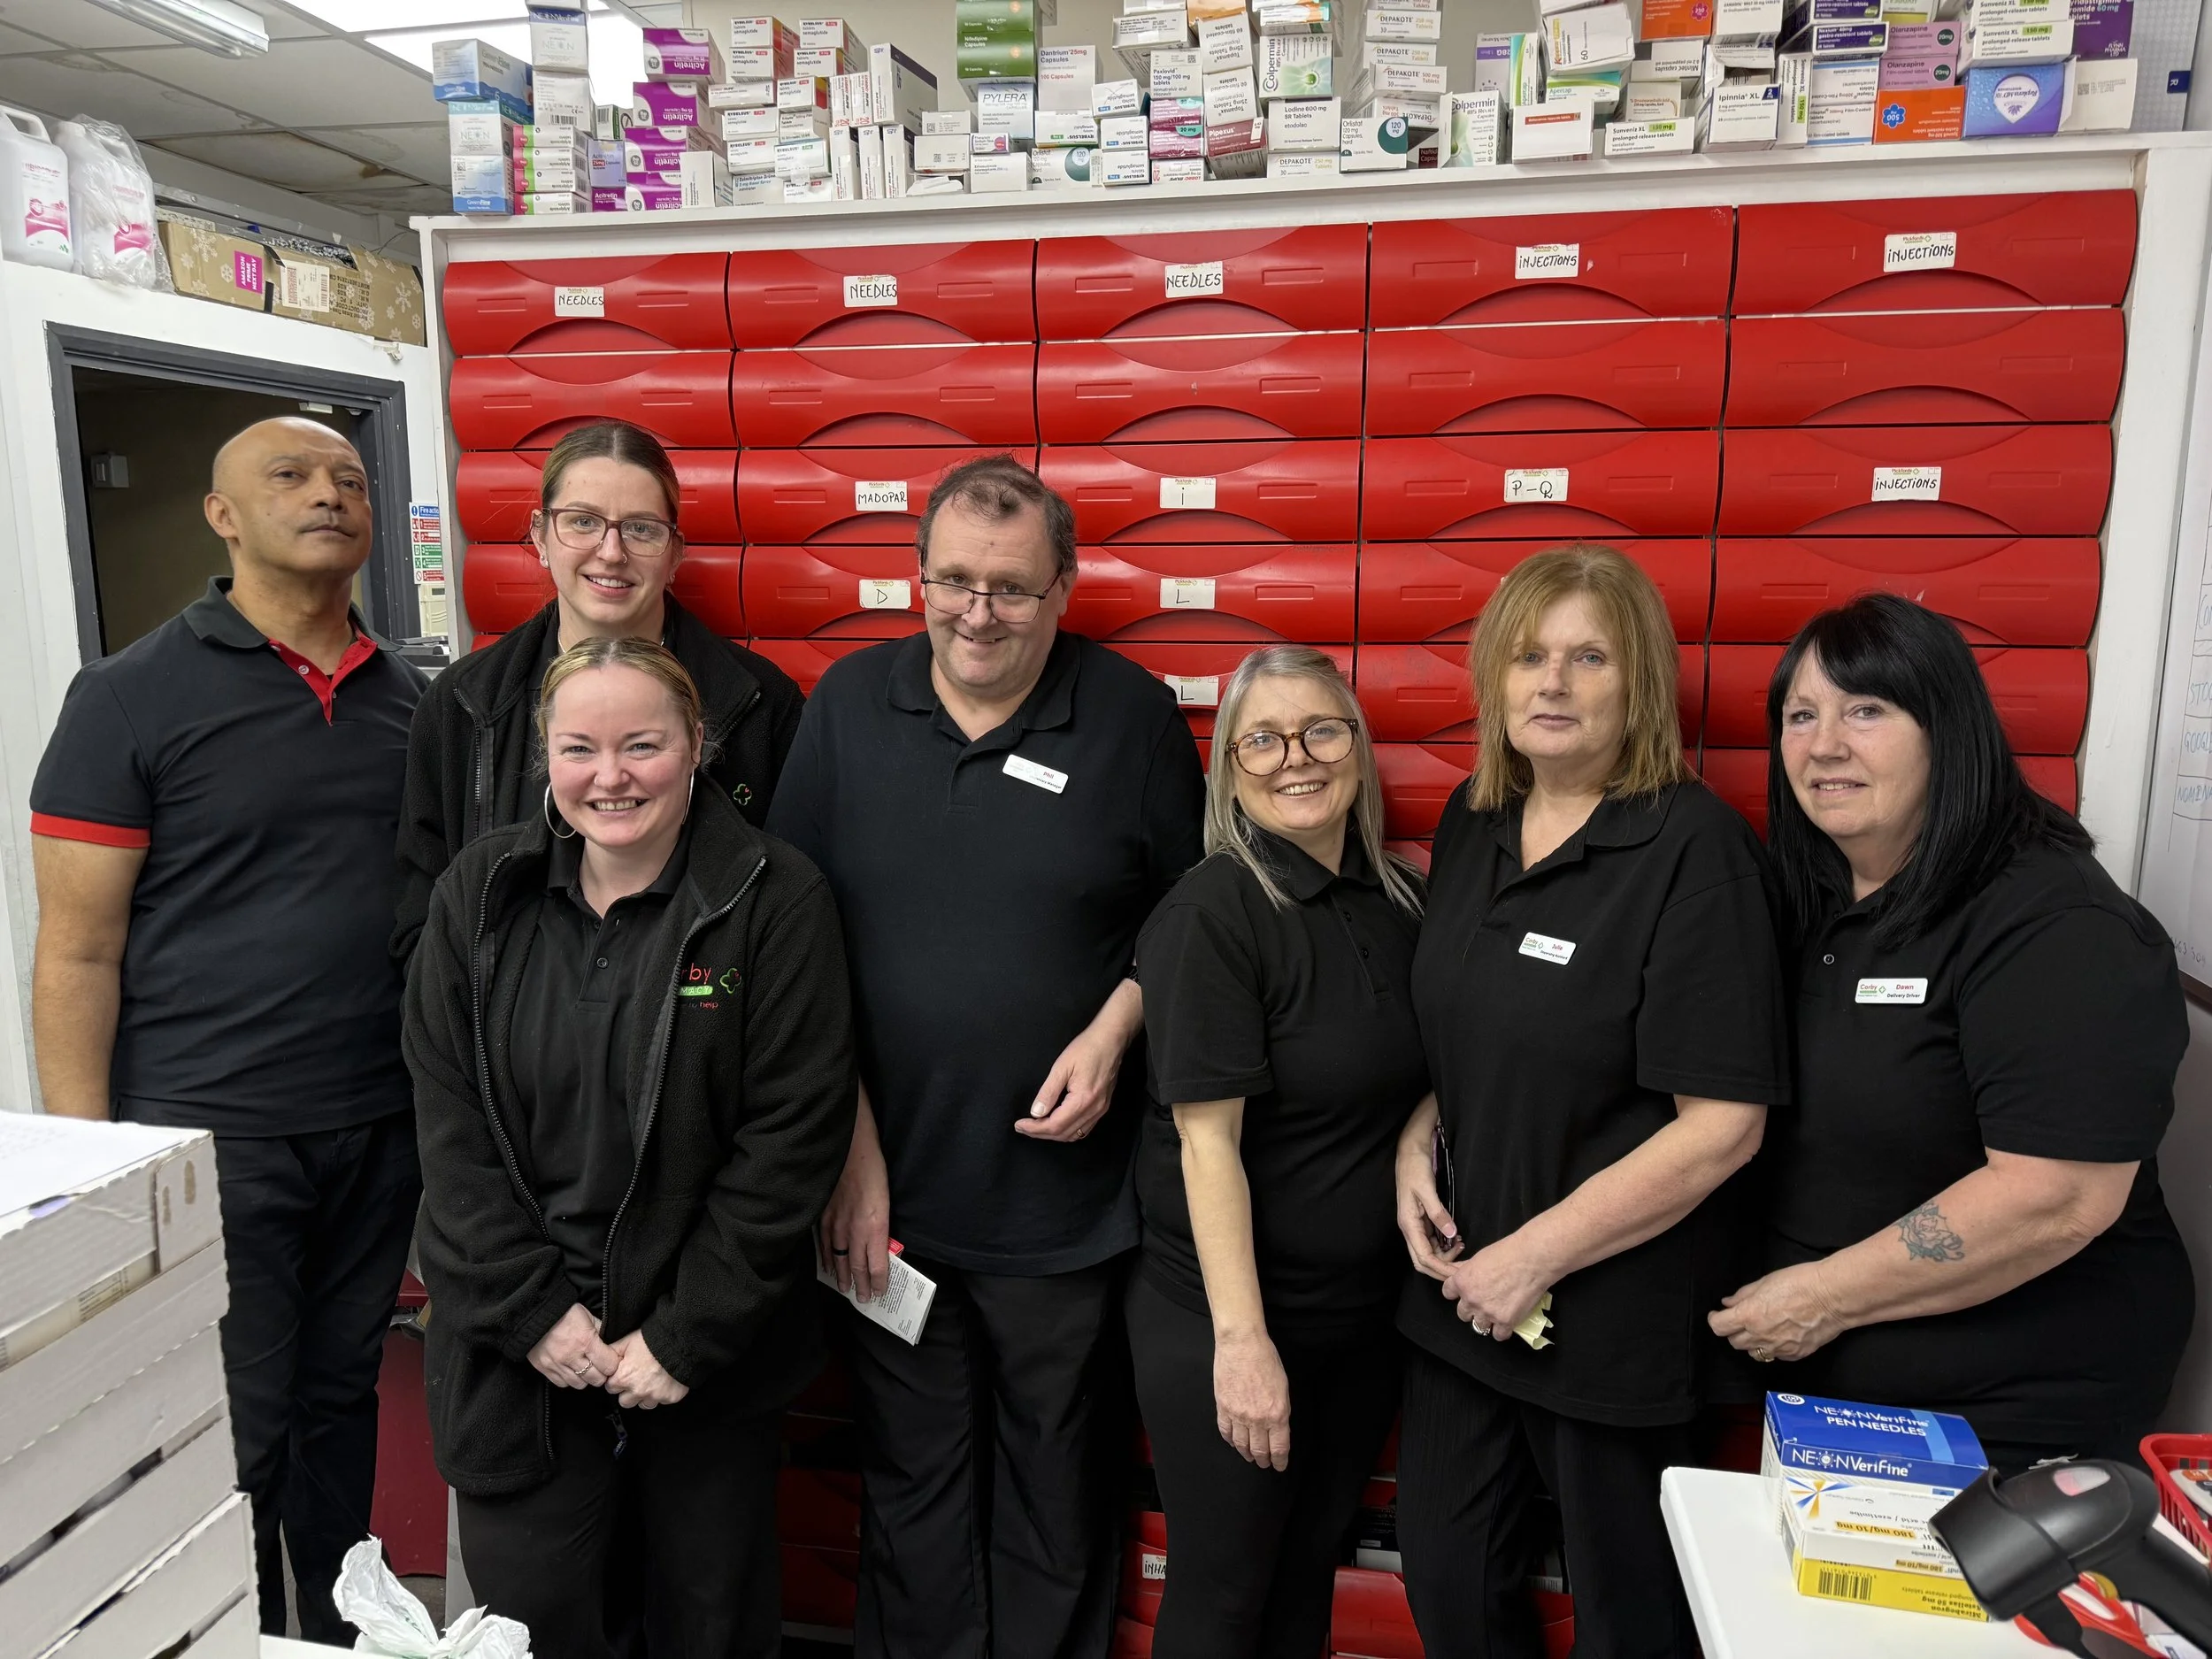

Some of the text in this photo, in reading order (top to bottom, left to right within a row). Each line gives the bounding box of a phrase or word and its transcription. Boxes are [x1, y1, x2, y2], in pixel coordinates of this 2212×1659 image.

[1580, 50, 1588, 60] 60
[1265, 38, 1278, 89] Colpermin
[983, 93, 1025, 103] PYLERA
[1718, 94, 1745, 103] Ipinnia
[1797, 111, 1803, 120] mg
[1209, 127, 1233, 136] Pipexus
[1166, 273, 1221, 289] NEEDLES
[849, 283, 897, 299] NEEDLES
[558, 295, 604, 306] NEEDLES
[1512, 480, 1553, 498] P Q
[857, 491, 907, 503] MADOPAR
[877, 588, 887, 604] D
[1176, 589, 1190, 603] L
[1181, 685, 1194, 701] L
[2177, 784, 2212, 803] NOMINA
[680, 963, 711, 985] rby
[1827, 1417, 1926, 1437] PEN NEEDLES
[1855, 1525, 1890, 1536] mg/10
[1144, 1560, 1165, 1575] iNHA
[1907, 1562, 1929, 1571] mg/10
[1931, 1606, 1981, 1618] Mirabegron
